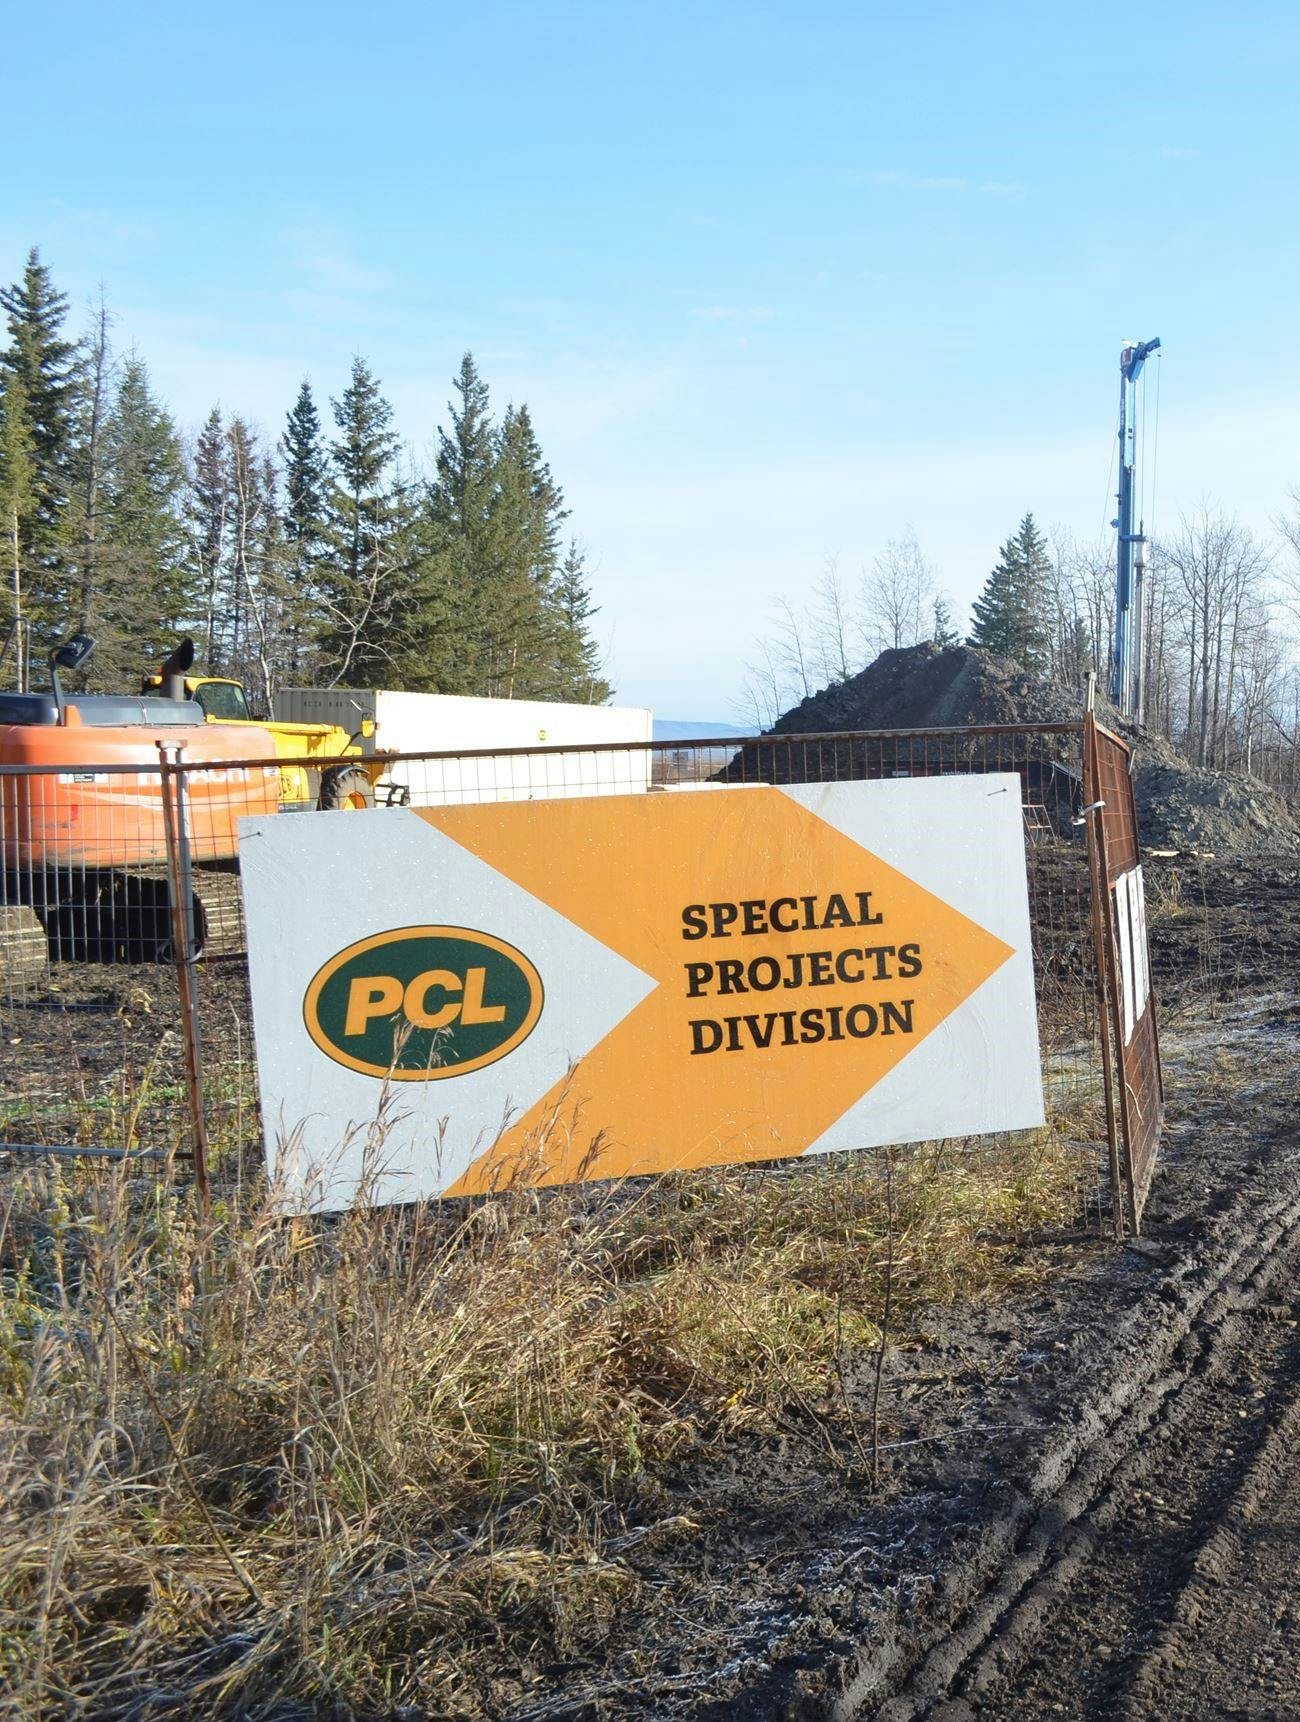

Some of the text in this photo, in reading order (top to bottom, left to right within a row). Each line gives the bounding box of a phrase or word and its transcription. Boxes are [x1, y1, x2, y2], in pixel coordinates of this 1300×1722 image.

[682, 891, 883, 940] SPECIAL
[684, 943, 923, 997] PROJECTS
[344, 967, 506, 1036] PCL
[688, 999, 915, 1055] DIVISION
